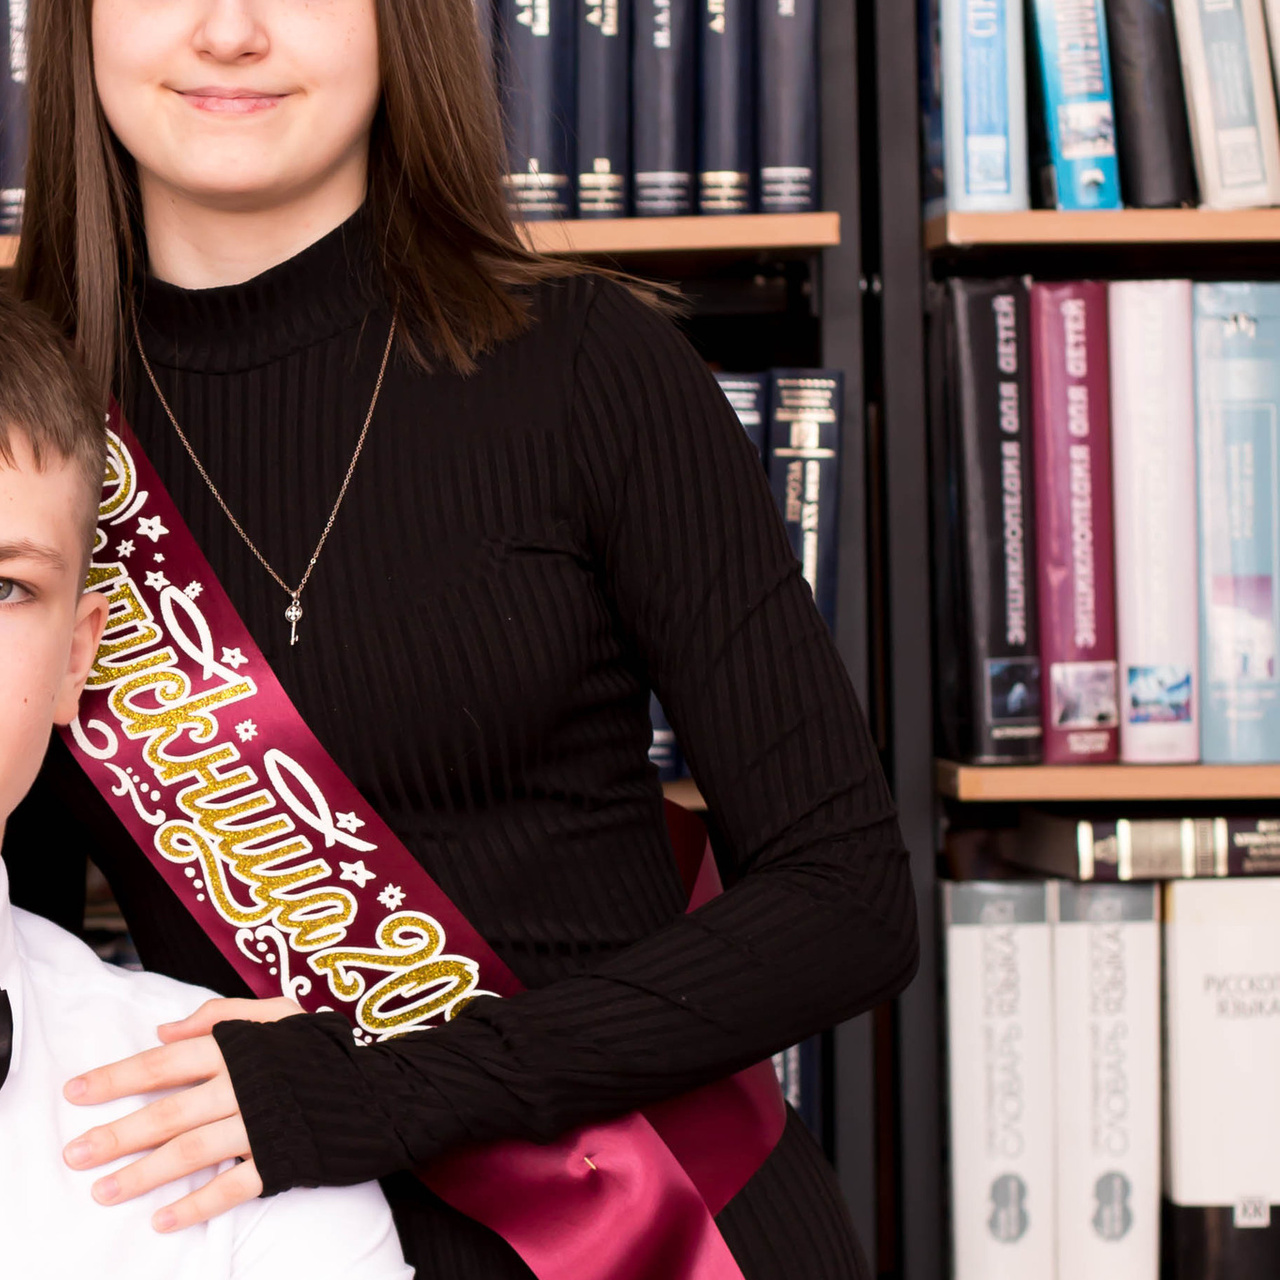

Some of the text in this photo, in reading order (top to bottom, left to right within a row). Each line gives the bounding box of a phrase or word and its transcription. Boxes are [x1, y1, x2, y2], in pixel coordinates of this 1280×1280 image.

[993, 296, 1017, 373] ДЕТЕЙ
[1061, 300, 1087, 377] ДЕТЕЙ
[1002, 442, 1026, 645] ЭНЦИКЛОПЕДИЯ
[1070, 445, 1096, 647] ЭНЦИКЛОПЕДИЯ
[309, 909, 503, 1038] 20
